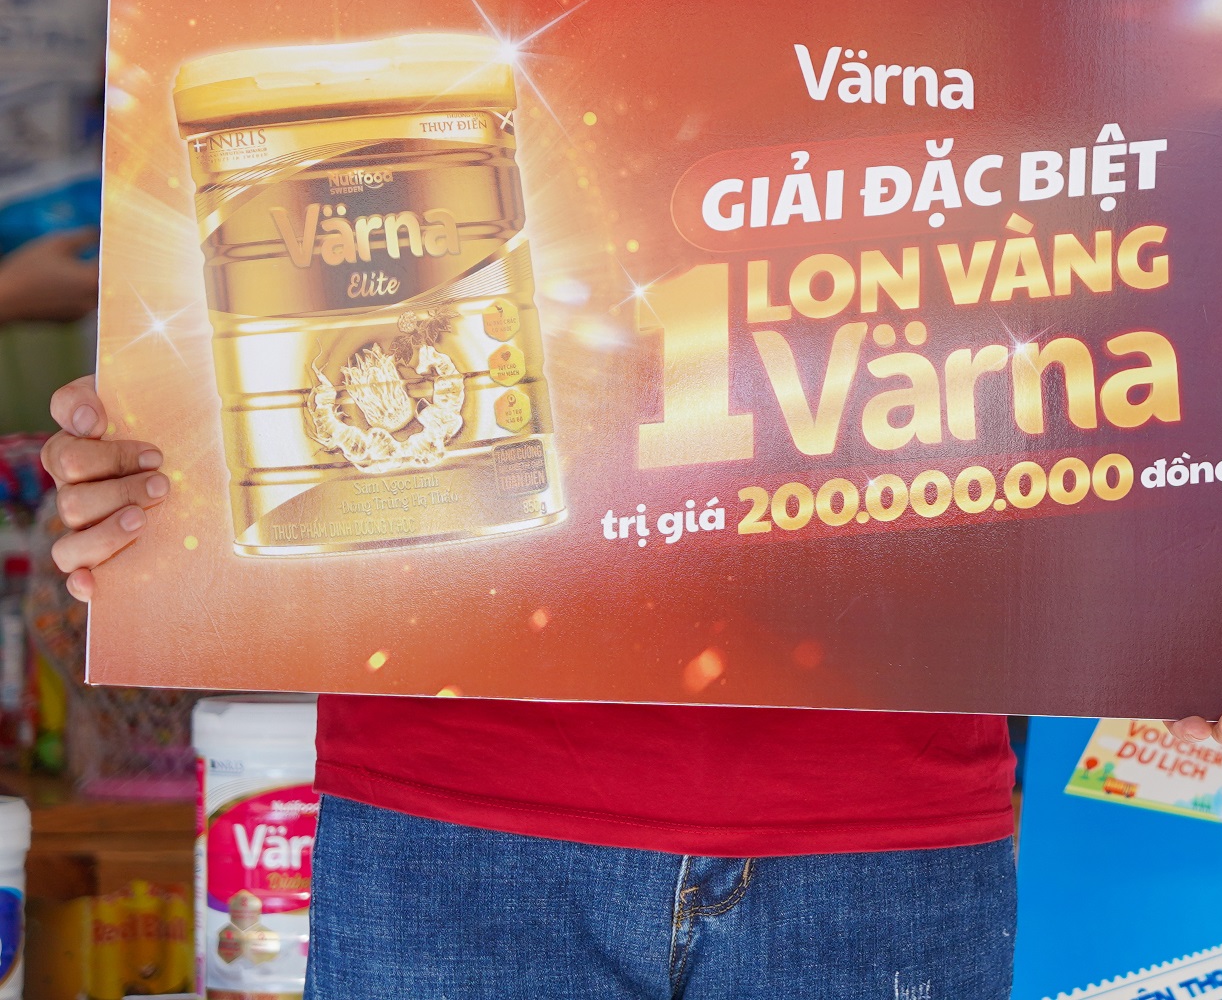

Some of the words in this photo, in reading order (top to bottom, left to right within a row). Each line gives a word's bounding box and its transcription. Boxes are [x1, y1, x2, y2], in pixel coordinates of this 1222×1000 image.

[793, 43, 975, 110] Värna
[327, 169, 394, 188] Nutifood
[329, 185, 364, 196] SWEDEN
[701, 150, 845, 231] GIẢI
[860, 137, 1005, 228] ĐẶC
[1018, 122, 1169, 212] BIỆT
[269, 202, 463, 270] Värna
[347, 269, 401, 299] Elite
[637, 262, 755, 470] 1
[746, 246, 921, 324] LON
[937, 212, 1170, 307] VÀNG
[750, 321, 1182, 458] Värna
[601, 503, 648, 547] trị
[657, 497, 727, 545] giá
[737, 452, 1135, 536] 200.000.000
[1116, 740, 1157, 764] DU
[1157, 752, 1208, 781] LỊCH
